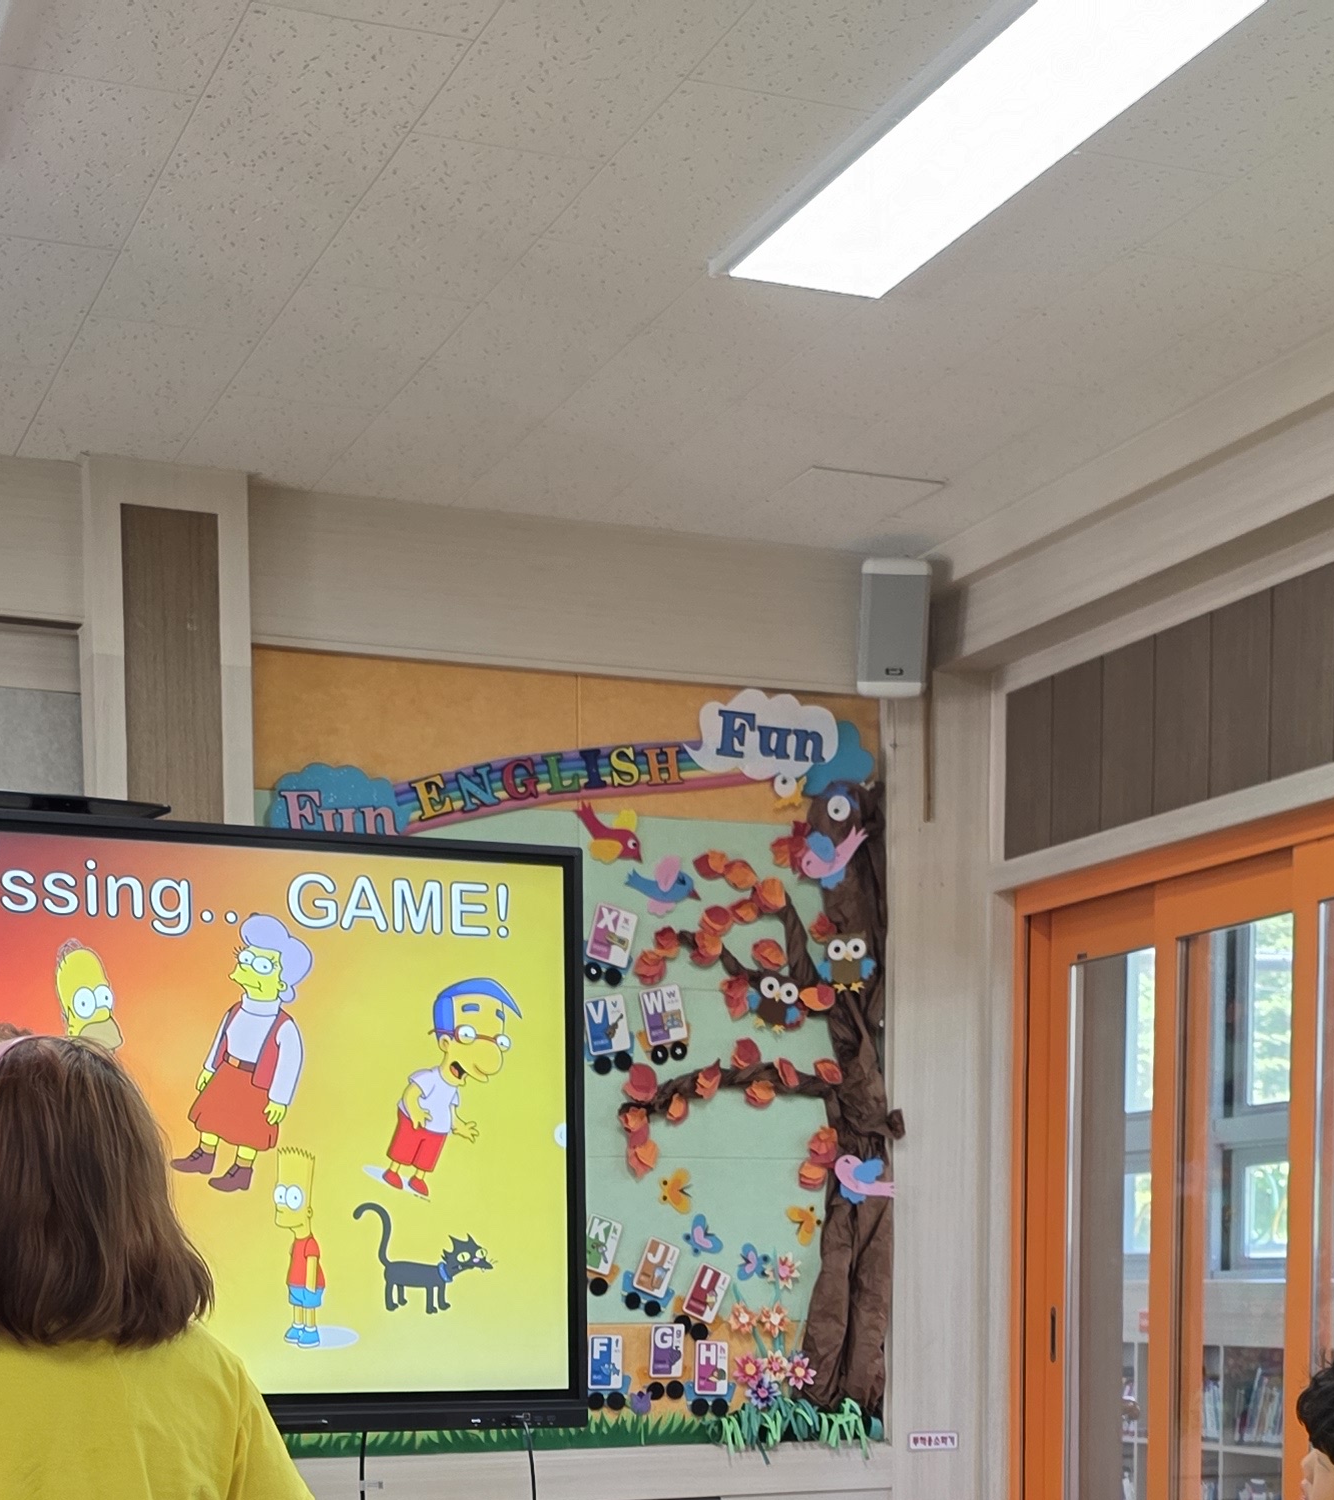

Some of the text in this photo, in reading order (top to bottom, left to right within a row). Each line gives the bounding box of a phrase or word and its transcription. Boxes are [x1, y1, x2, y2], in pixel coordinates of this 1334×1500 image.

[717, 709, 825, 763] Fun
[280, 745, 683, 836] Fun ENGLISH
[286, 872, 511, 940] GAME!
[597, 907, 618, 933] X
[586, 1000, 604, 1024] V
[643, 991, 663, 1015] W
[589, 1218, 610, 1242] K
[647, 1243, 666, 1264] J
[593, 1338, 608, 1360] F
[654, 1328, 674, 1349] G
[700, 1344, 717, 1366] H
